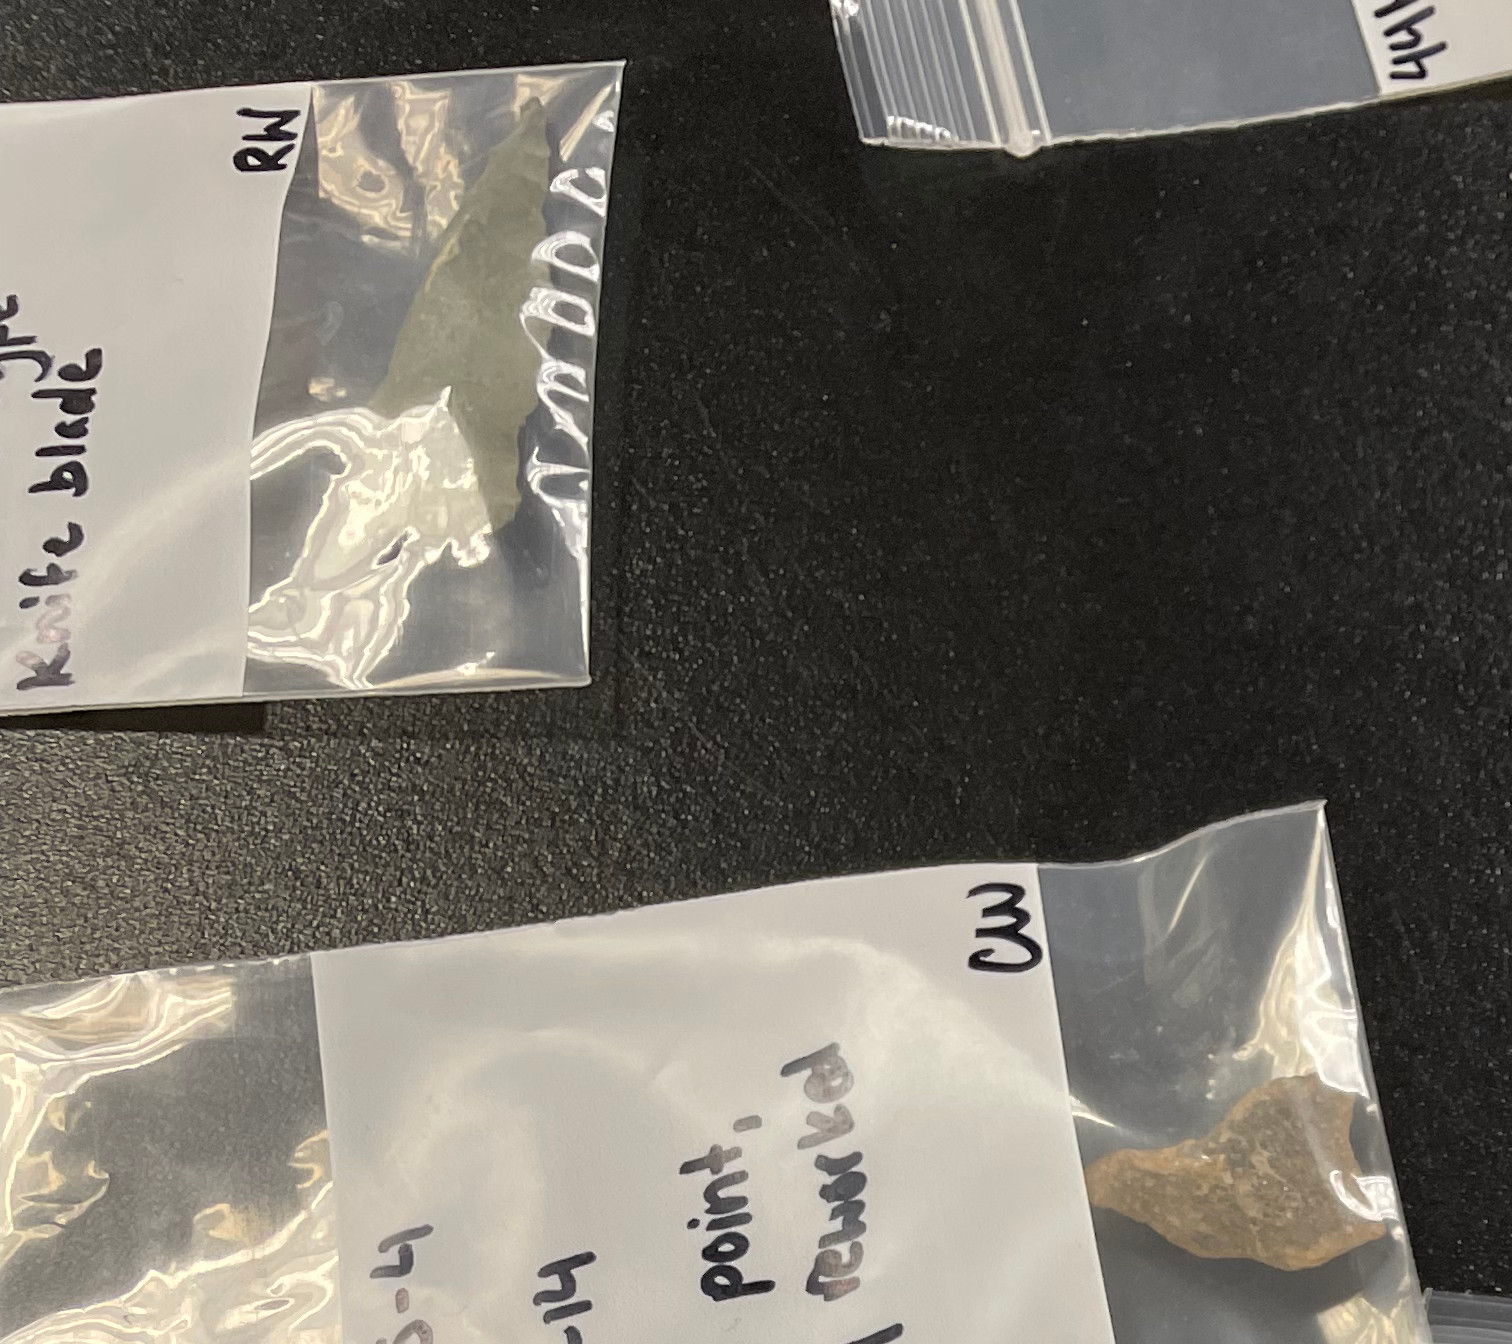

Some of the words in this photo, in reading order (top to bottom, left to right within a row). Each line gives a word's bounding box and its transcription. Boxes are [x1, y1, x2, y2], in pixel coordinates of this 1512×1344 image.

[233, 107, 301, 173] RW
[28, 347, 103, 498] blade
[16, 520, 85, 690] Knife
[780, 1041, 869, 1300] reworked
